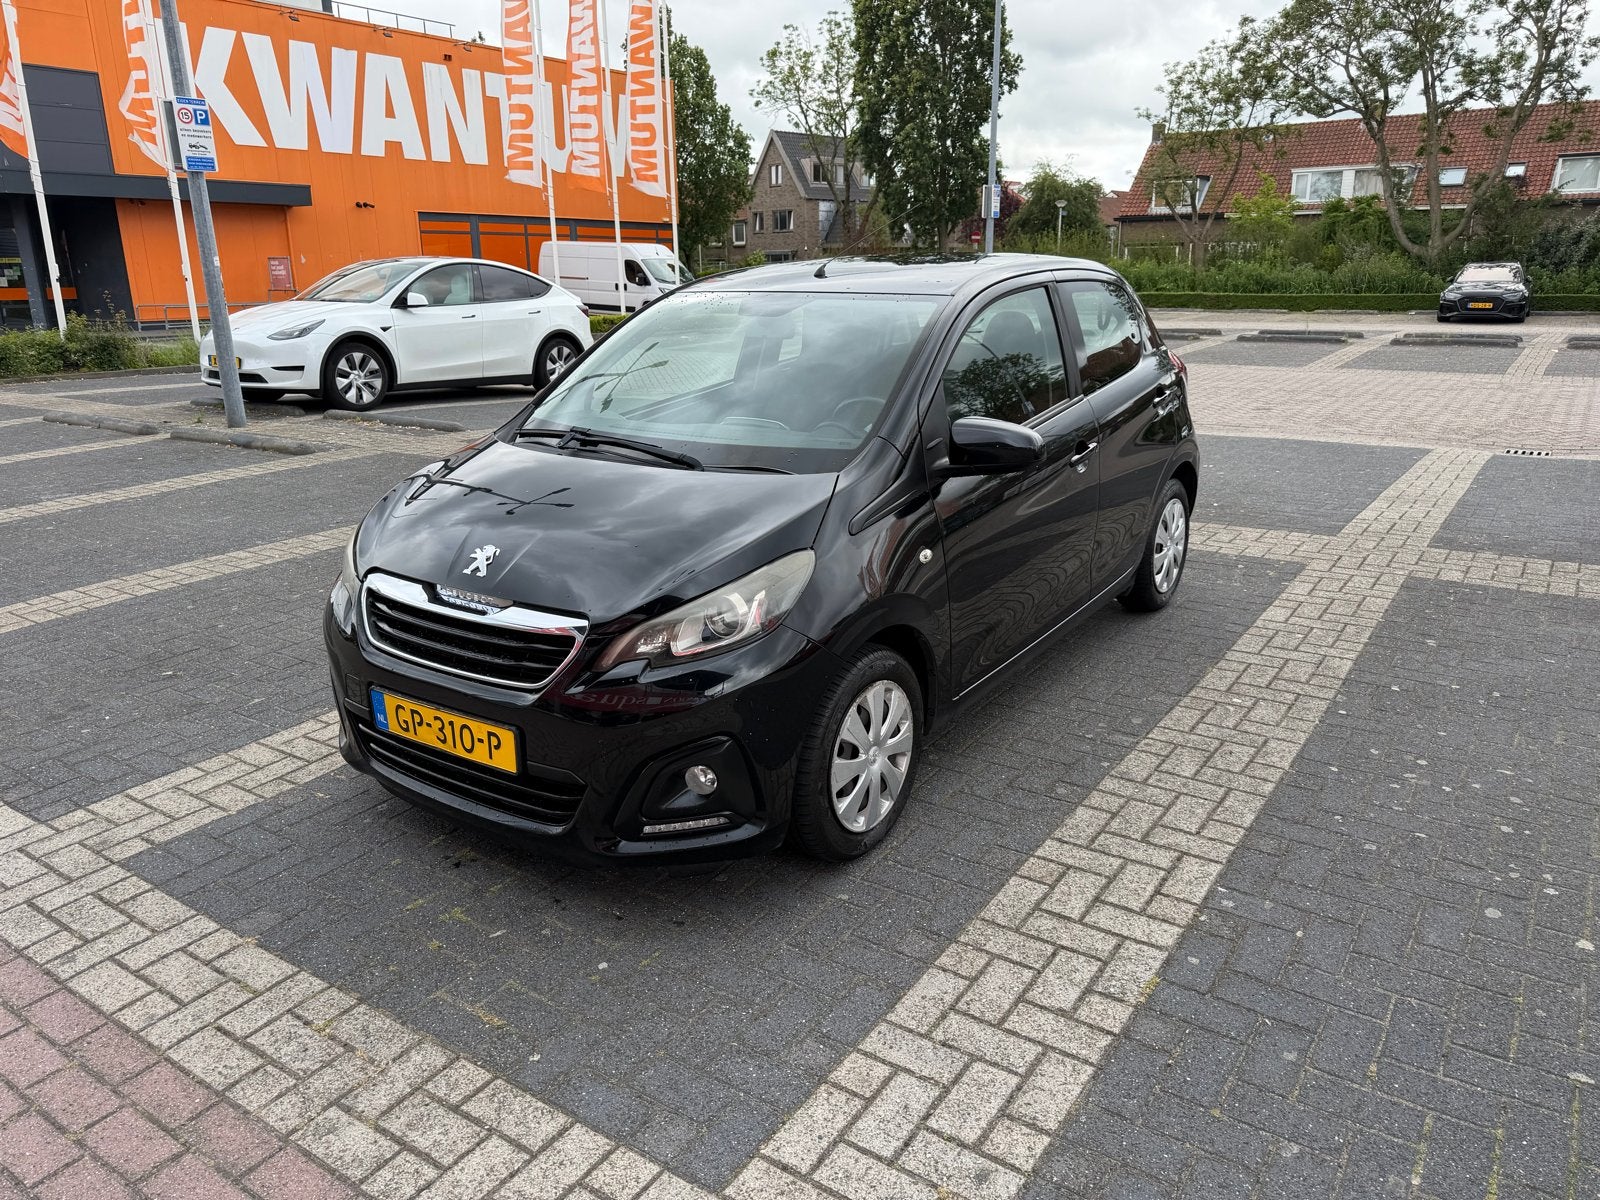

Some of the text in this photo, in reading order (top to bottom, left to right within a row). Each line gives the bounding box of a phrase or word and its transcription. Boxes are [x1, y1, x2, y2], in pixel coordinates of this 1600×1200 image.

[181, 111, 190, 120] 15
[196, 110, 206, 124] P
[377, 712, 387, 724] NL
[395, 703, 502, 760] GP-310-P
